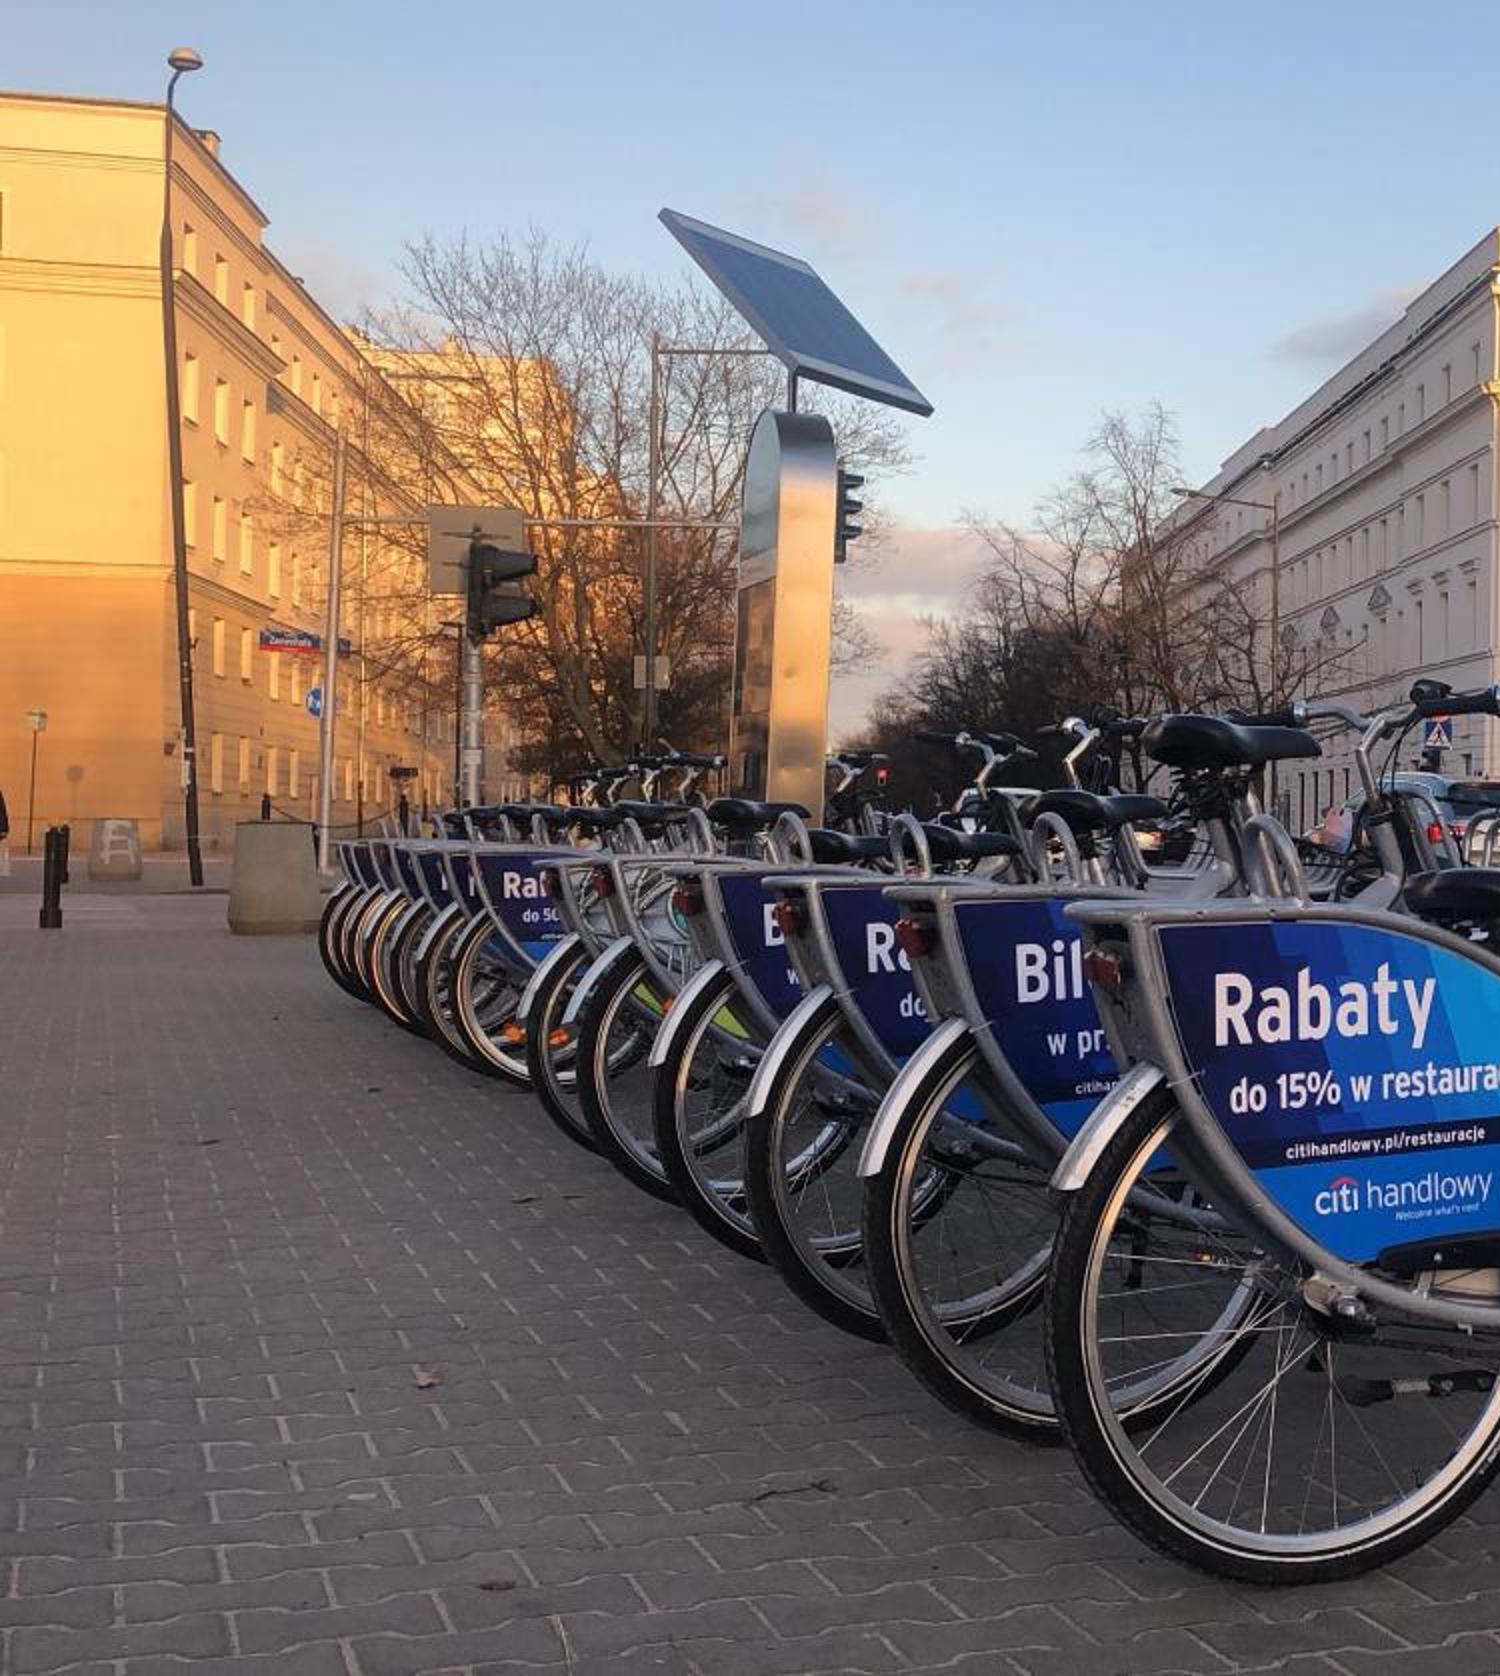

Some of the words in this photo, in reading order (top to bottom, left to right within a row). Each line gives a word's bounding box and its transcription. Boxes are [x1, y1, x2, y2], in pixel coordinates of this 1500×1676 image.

[1016, 939, 1083, 1003] Bil
[1215, 961, 1437, 1049] Rabaty
[1047, 1033, 1067, 1056] w
[1230, 1077, 1267, 1113] do
[1276, 1070, 1341, 1109] 15%
[1350, 1075, 1373, 1102] w
[1286, 1125, 1487, 1160] citihandlowy.pl/restauracje
[1366, 1172, 1493, 1210] handlowy
